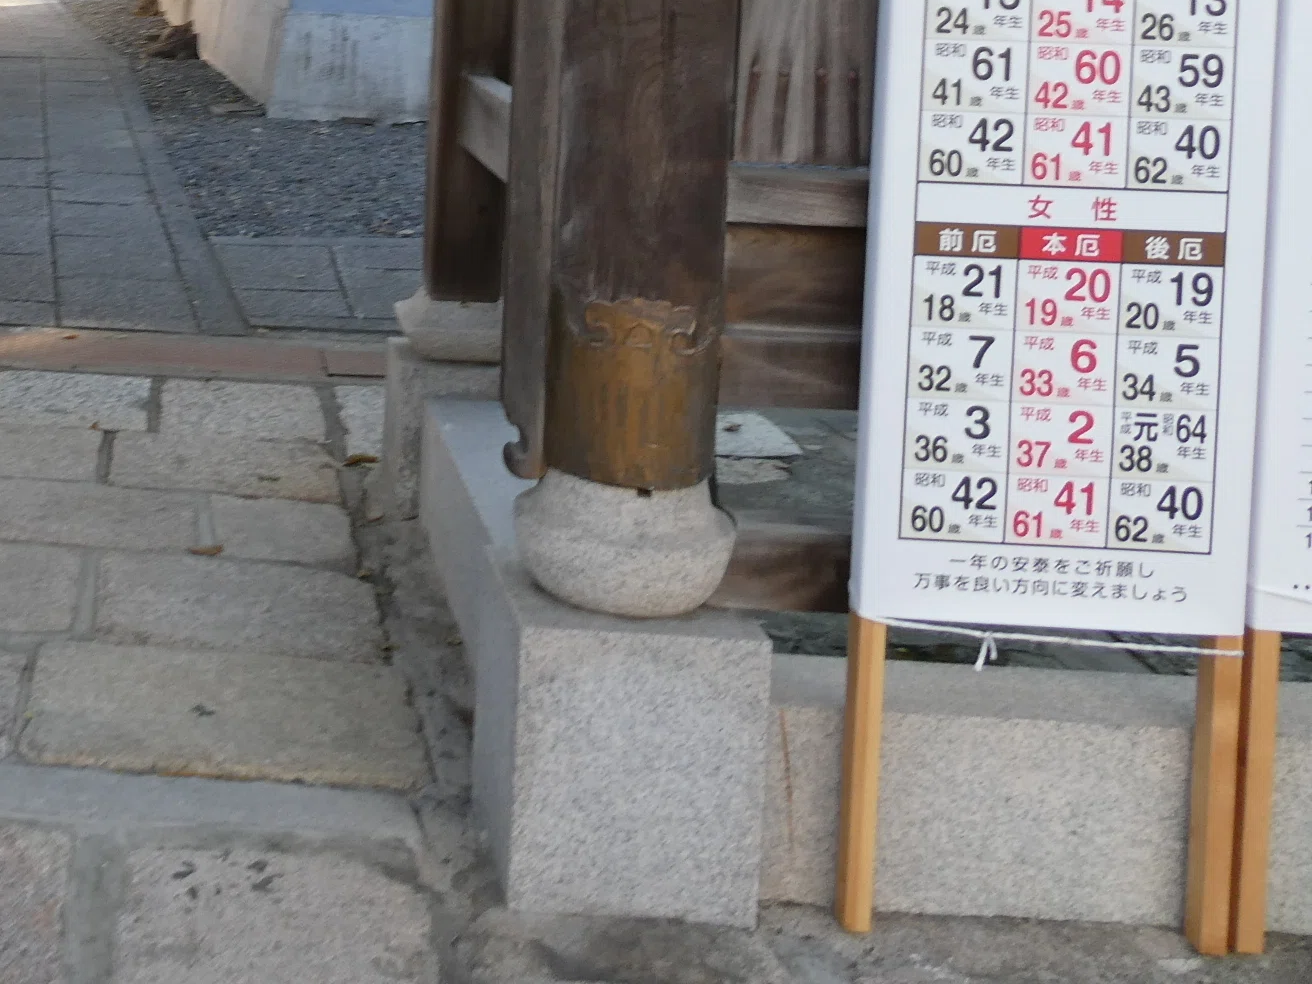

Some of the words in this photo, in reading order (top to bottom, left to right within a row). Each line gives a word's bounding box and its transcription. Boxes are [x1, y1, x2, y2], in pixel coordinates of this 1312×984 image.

[993, 15, 1023, 30] 年生
[1096, 17, 1126, 33] 年生
[1197, 21, 1228, 35] 年生
[936, 43, 965, 58] 昭和
[1038, 46, 1068, 62] 昭和
[1140, 49, 1171, 64] 昭和
[972, 46, 1011, 82] 61
[1075, 50, 1120, 85] 60
[1178, 54, 1223, 88] 59
[989, 86, 1019, 101] 年生
[1092, 89, 1122, 104] 年生
[1195, 92, 1224, 107] 年生
[932, 114, 962, 129] 昭和
[1034, 118, 1065, 133] 昭和
[1137, 121, 1167, 136] 昭和
[968, 118, 1014, 153] 42
[1071, 122, 1112, 157] 41
[1175, 125, 1220, 160] 40
[986, 157, 1015, 172] 年生
[1089, 161, 1118, 176] 年生
[1191, 165, 1221, 179] 年生
[1029, 196, 1118, 222] 女性
[939, 229, 997, 253] 前厄
[1042, 233, 1100, 257] 本厄
[1144, 237, 1203, 261] 後厄
[926, 261, 956, 276] 平成
[1028, 265, 1058, 280] 平成
[962, 264, 1003, 299] 21
[1131, 269, 1161, 284] 平成
[1064, 268, 1110, 303] 20
[1170, 272, 1213, 307] 19
[978, 302, 1008, 317] 年生
[1081, 306, 1110, 321] 年生
[1183, 310, 1213, 325] 年生
[922, 332, 952, 347] 平成
[1023, 336, 1054, 351] 平成
[968, 335, 996, 369] 7
[1127, 340, 1158, 355] 平成
[1070, 339, 1097, 374] 6
[1173, 343, 1201, 378] 5
[975, 373, 1005, 388] 年生
[1077, 377, 1108, 392] 年生
[1179, 382, 1210, 396] 年生
[918, 403, 948, 417] 平成
[1021, 407, 1051, 422] 平成
[965, 405, 991, 440] 3
[1068, 410, 1094, 445] 2
[1134, 413, 1158, 442] 元
[1175, 414, 1207, 444] 64
[971, 444, 1002, 459] 年生
[1074, 448, 1104, 463] 年生
[1176, 445, 1207, 460] 年生
[915, 473, 945, 488] 昭和
[1017, 478, 1048, 492] 昭和
[952, 476, 997, 511] 42
[1120, 482, 1150, 498] 昭和
[1054, 481, 1095, 515] 41
[1157, 485, 1203, 521] 40
[968, 514, 998, 529] 年生
[1070, 519, 1100, 533] 年生
[1172, 524, 1202, 538] 年生
[949, 554, 1154, 578] 一年の安泰をご祈願し
[914, 572, 1187, 603] 万事を良い方向に変えましょう
